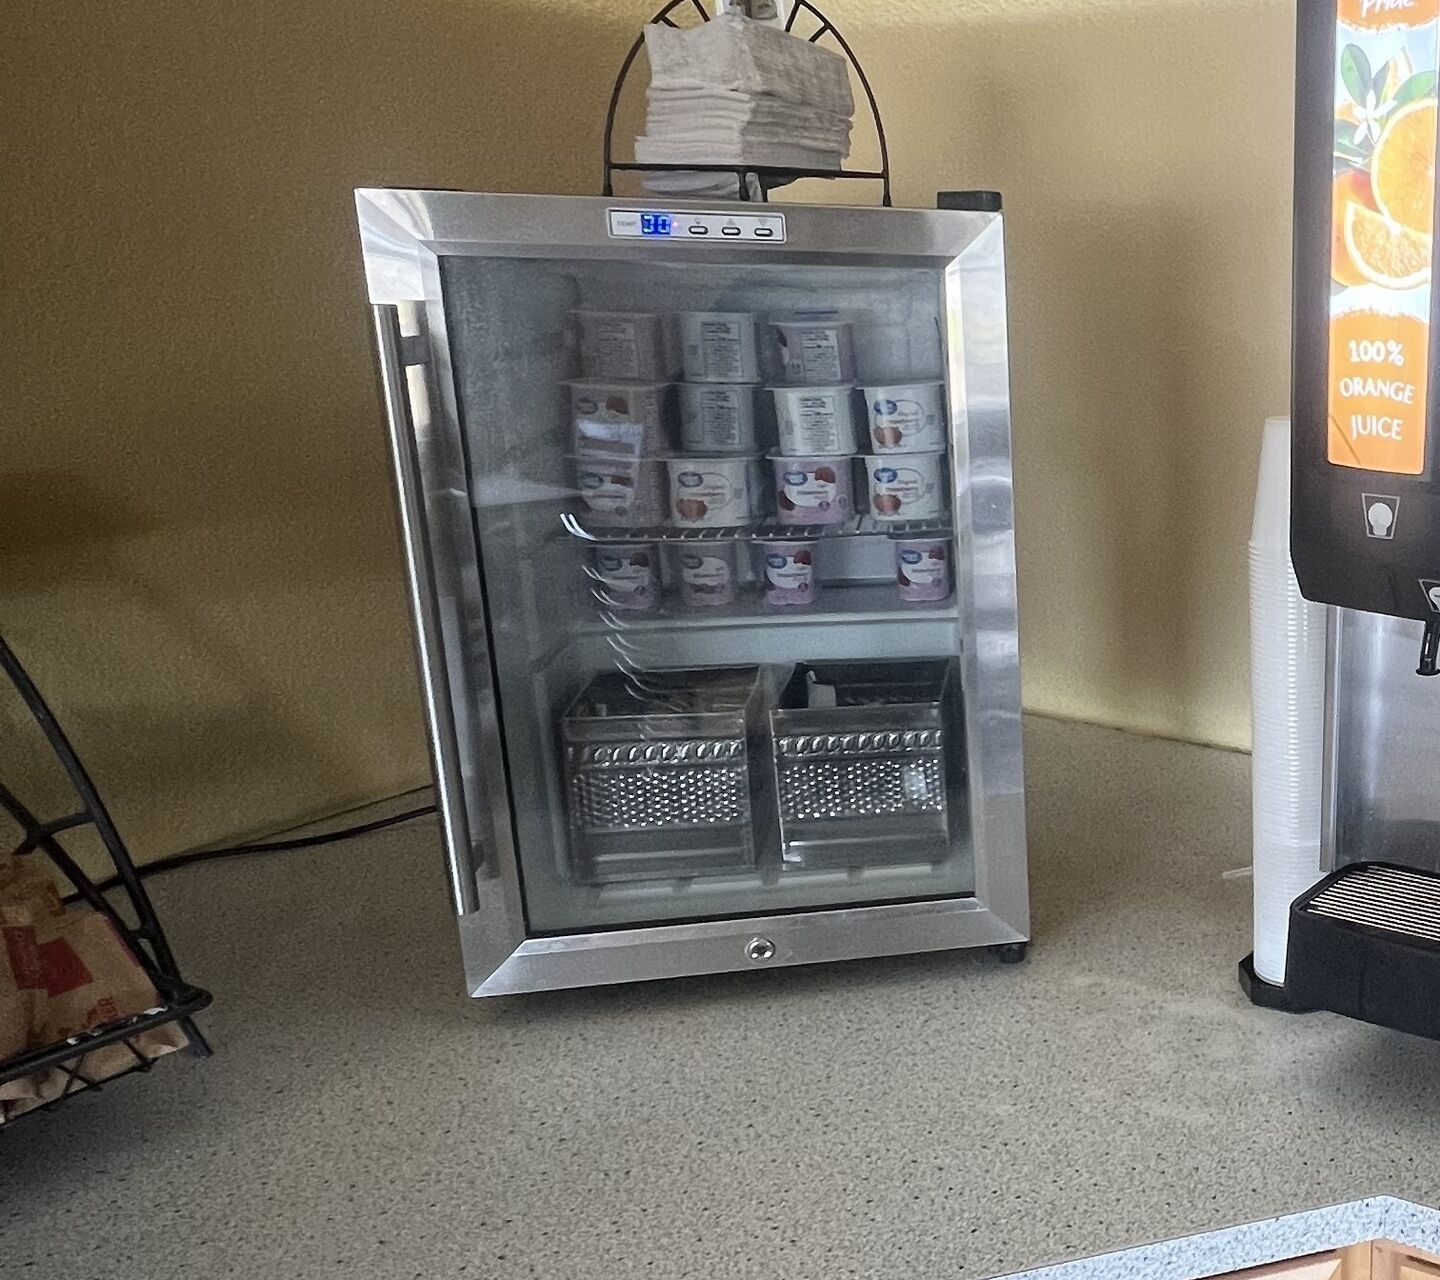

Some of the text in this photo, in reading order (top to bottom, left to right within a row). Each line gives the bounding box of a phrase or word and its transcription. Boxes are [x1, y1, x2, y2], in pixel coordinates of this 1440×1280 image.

[1348, 339, 1405, 367] 100%
[1339, 376, 1416, 406] ORANGE
[1350, 413, 1404, 441] JUICE
